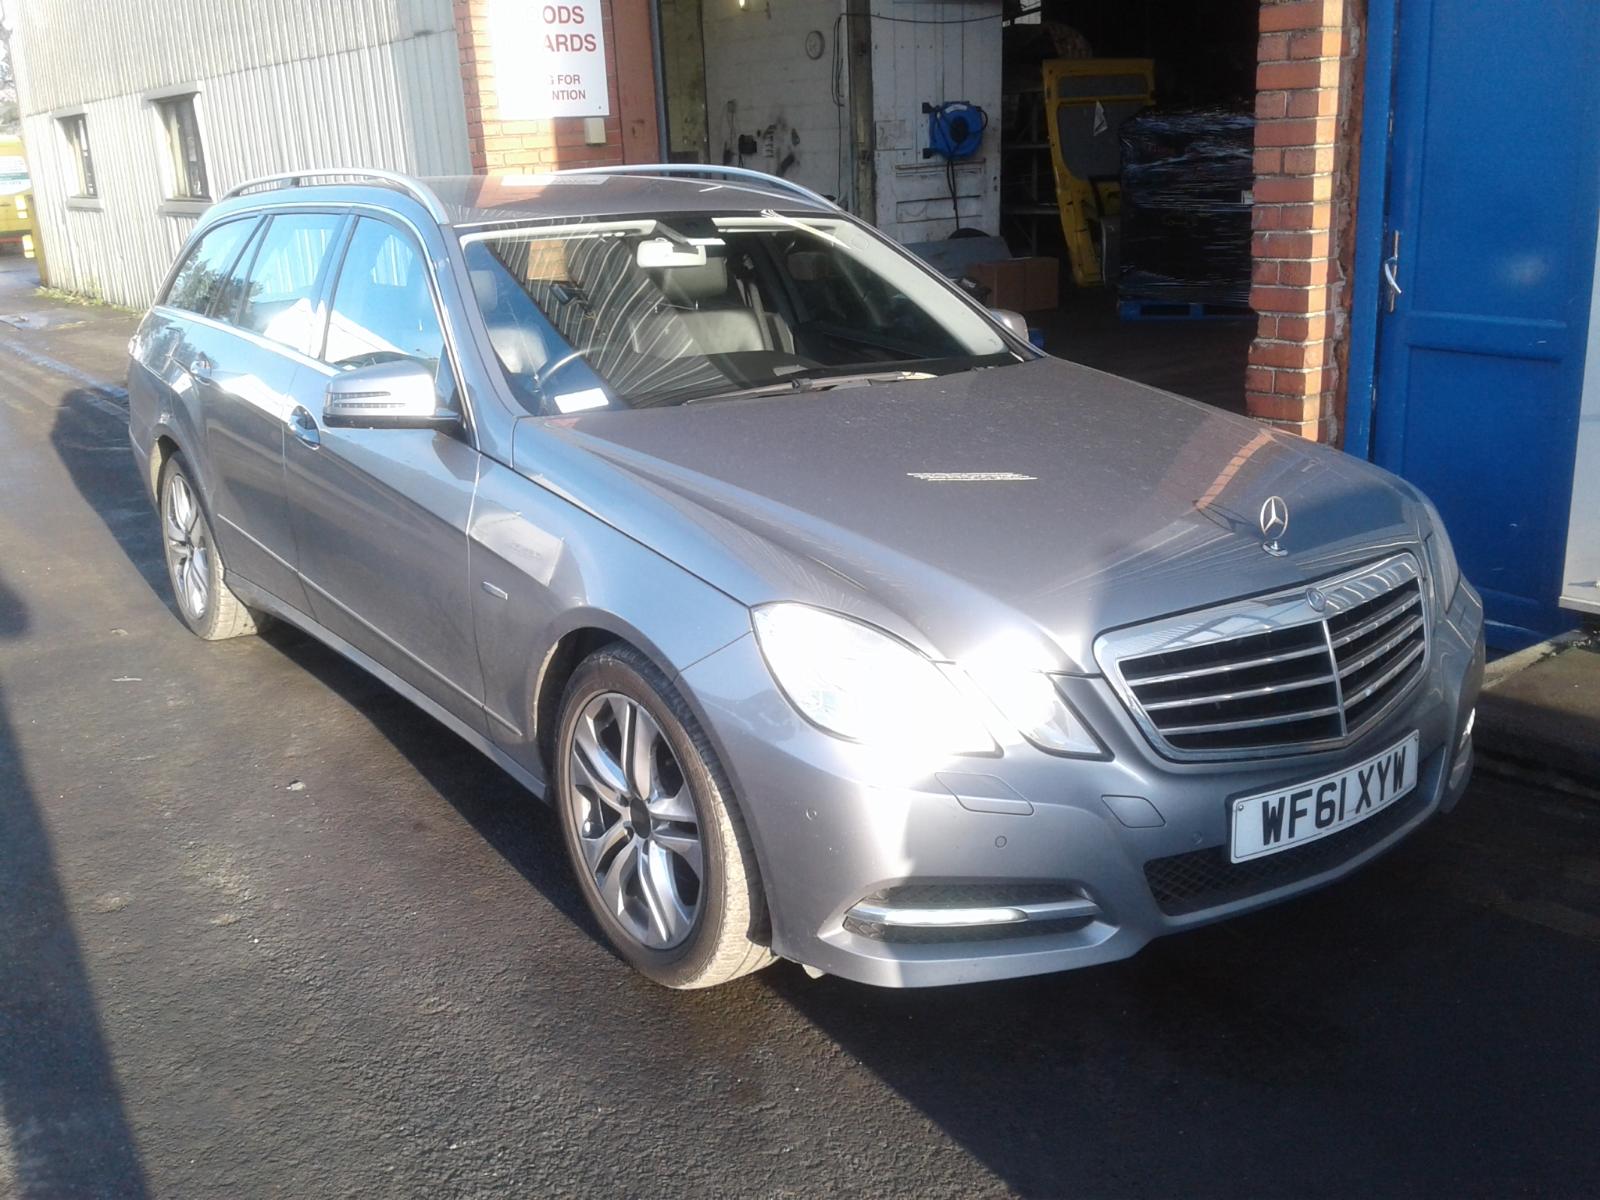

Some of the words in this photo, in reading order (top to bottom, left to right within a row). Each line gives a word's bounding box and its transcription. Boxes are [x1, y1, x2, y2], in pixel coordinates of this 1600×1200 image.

[542, 5, 585, 24] ODS
[544, 33, 597, 52] ARDS
[557, 74, 581, 85] FOR
[552, 89, 587, 101] NTION
